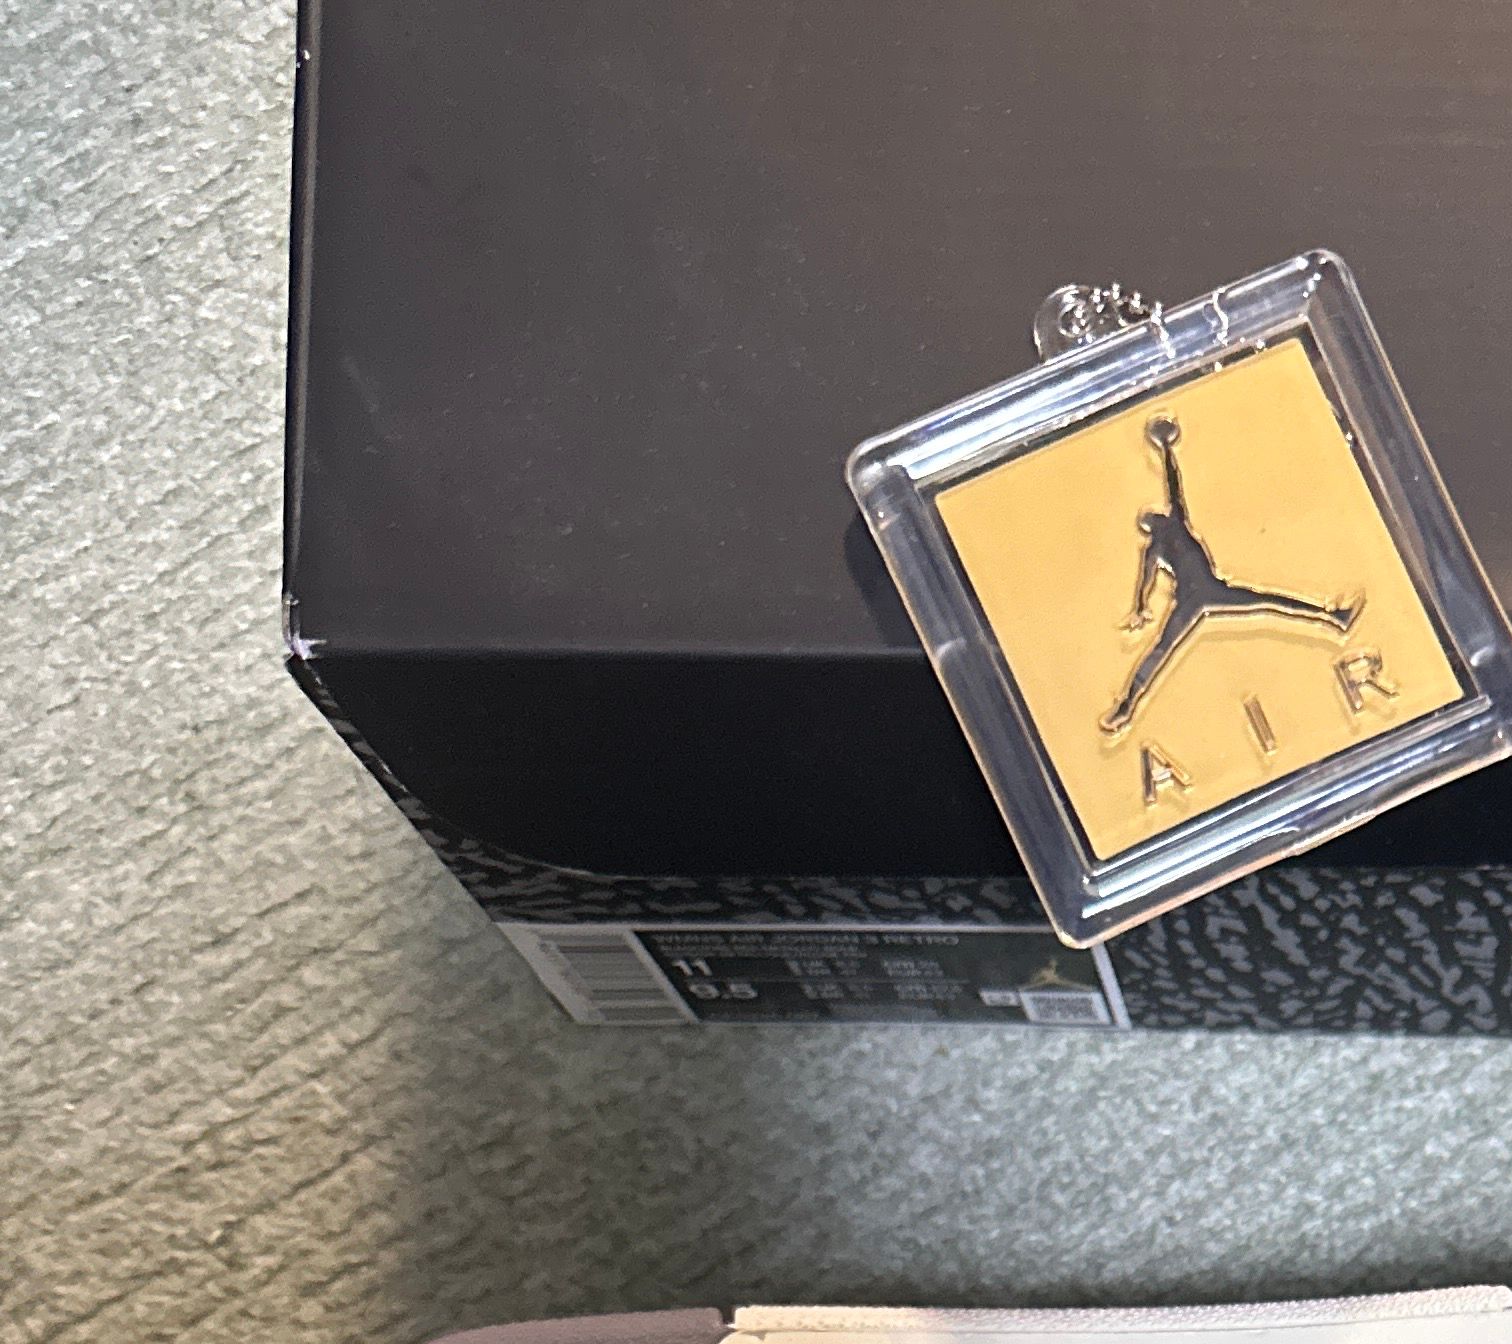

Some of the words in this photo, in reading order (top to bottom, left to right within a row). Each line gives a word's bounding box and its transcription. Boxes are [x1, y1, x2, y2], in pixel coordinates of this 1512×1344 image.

[1141, 649, 1399, 805] AIR
[882, 934, 960, 946] RETRO
[671, 959, 713, 977] 11
